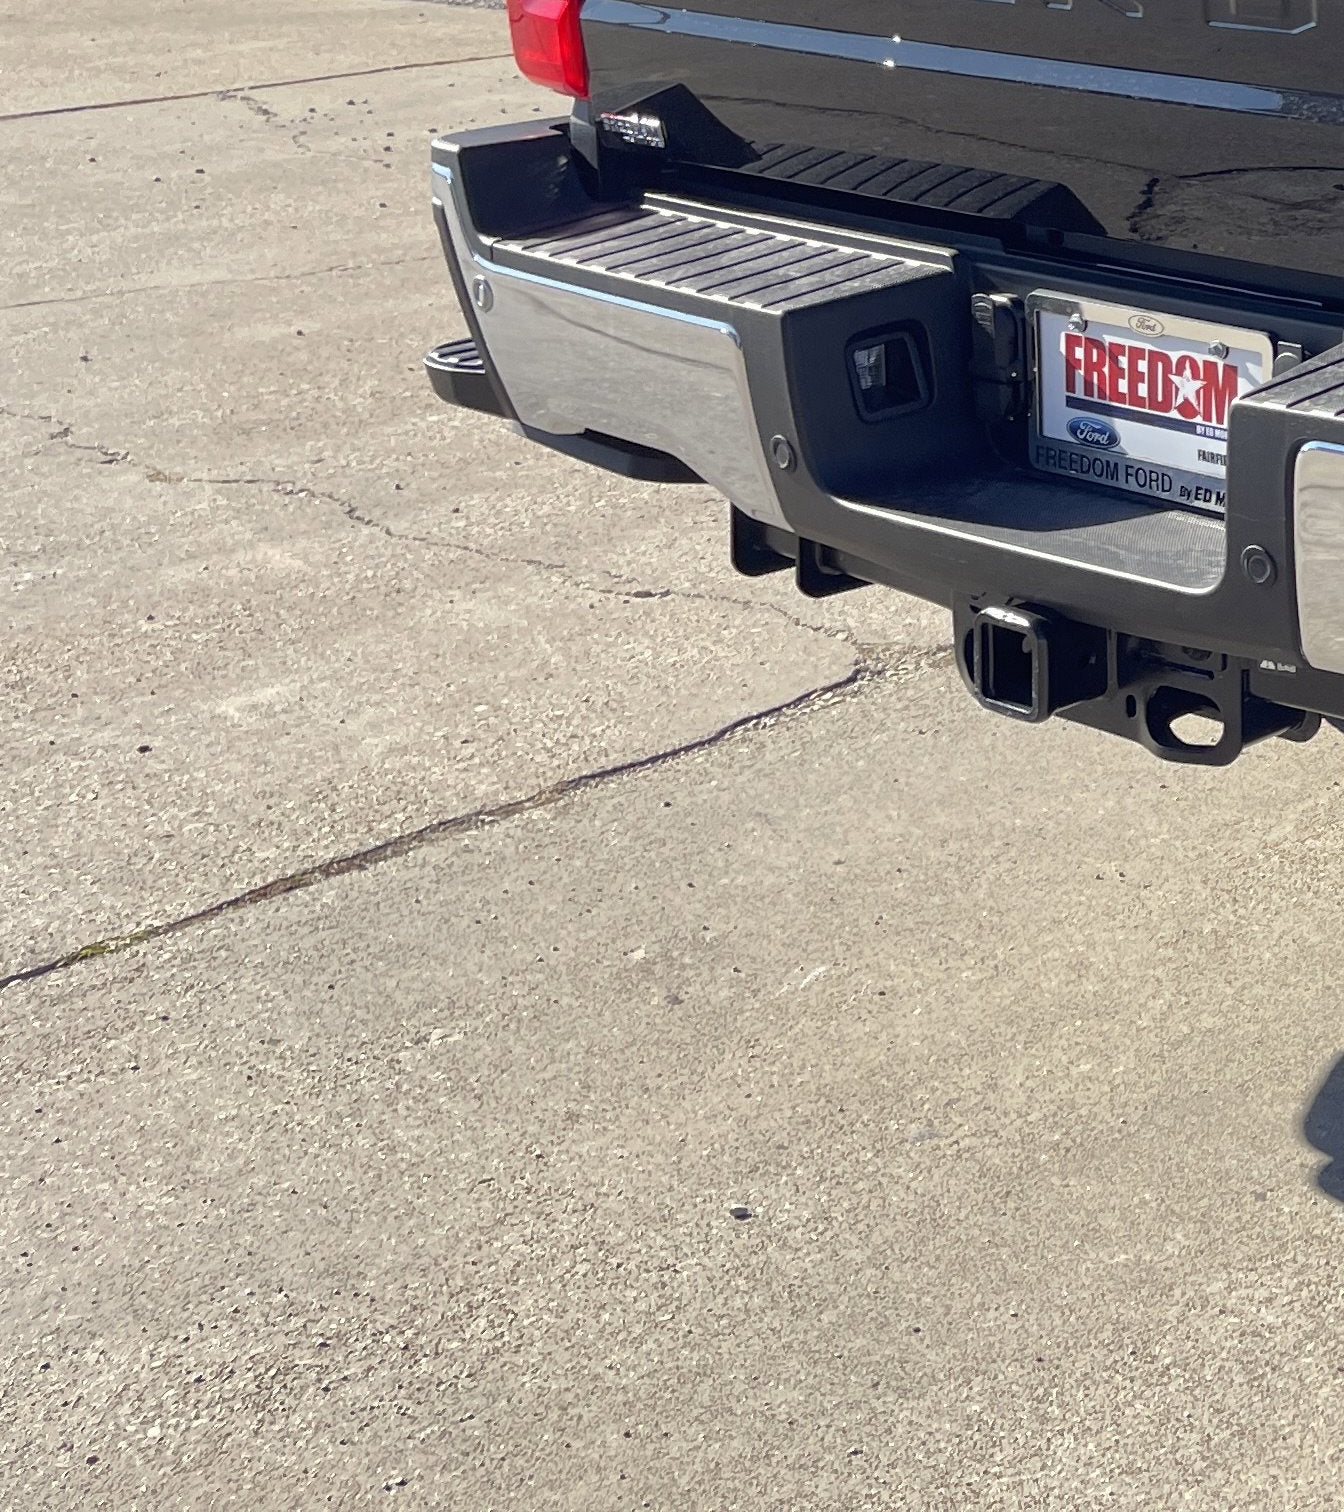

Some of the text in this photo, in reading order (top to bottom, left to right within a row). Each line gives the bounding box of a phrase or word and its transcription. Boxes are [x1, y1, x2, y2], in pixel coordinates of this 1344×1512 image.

[1064, 332, 1239, 426] FREEDOM
[1035, 444, 1120, 483] FREEDOM
[1124, 464, 1173, 494] FORD
[1194, 486, 1213, 504] ED
